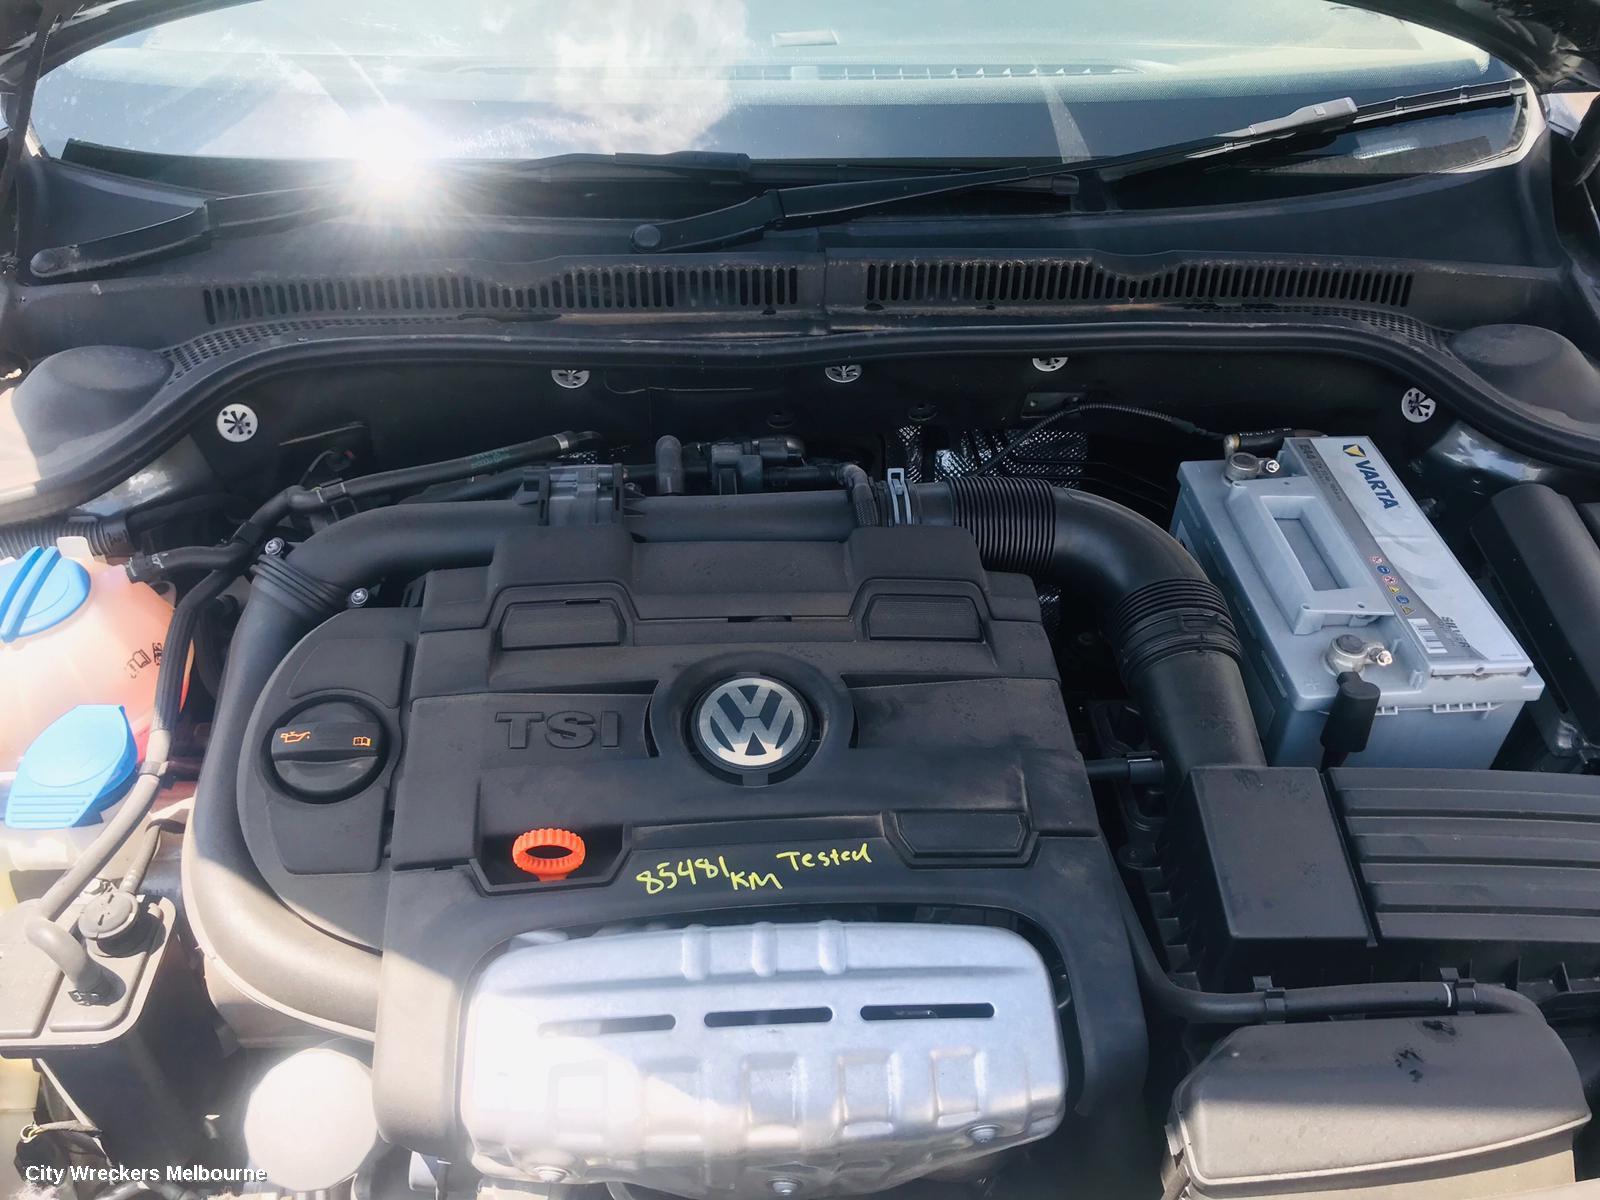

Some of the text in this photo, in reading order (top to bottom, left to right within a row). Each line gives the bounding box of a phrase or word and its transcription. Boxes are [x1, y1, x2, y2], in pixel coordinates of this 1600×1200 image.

[1355, 459, 1399, 509] VARTA
[495, 710, 621, 750] TSI
[635, 855, 730, 895] 85481
[775, 842, 873, 872] Tested
